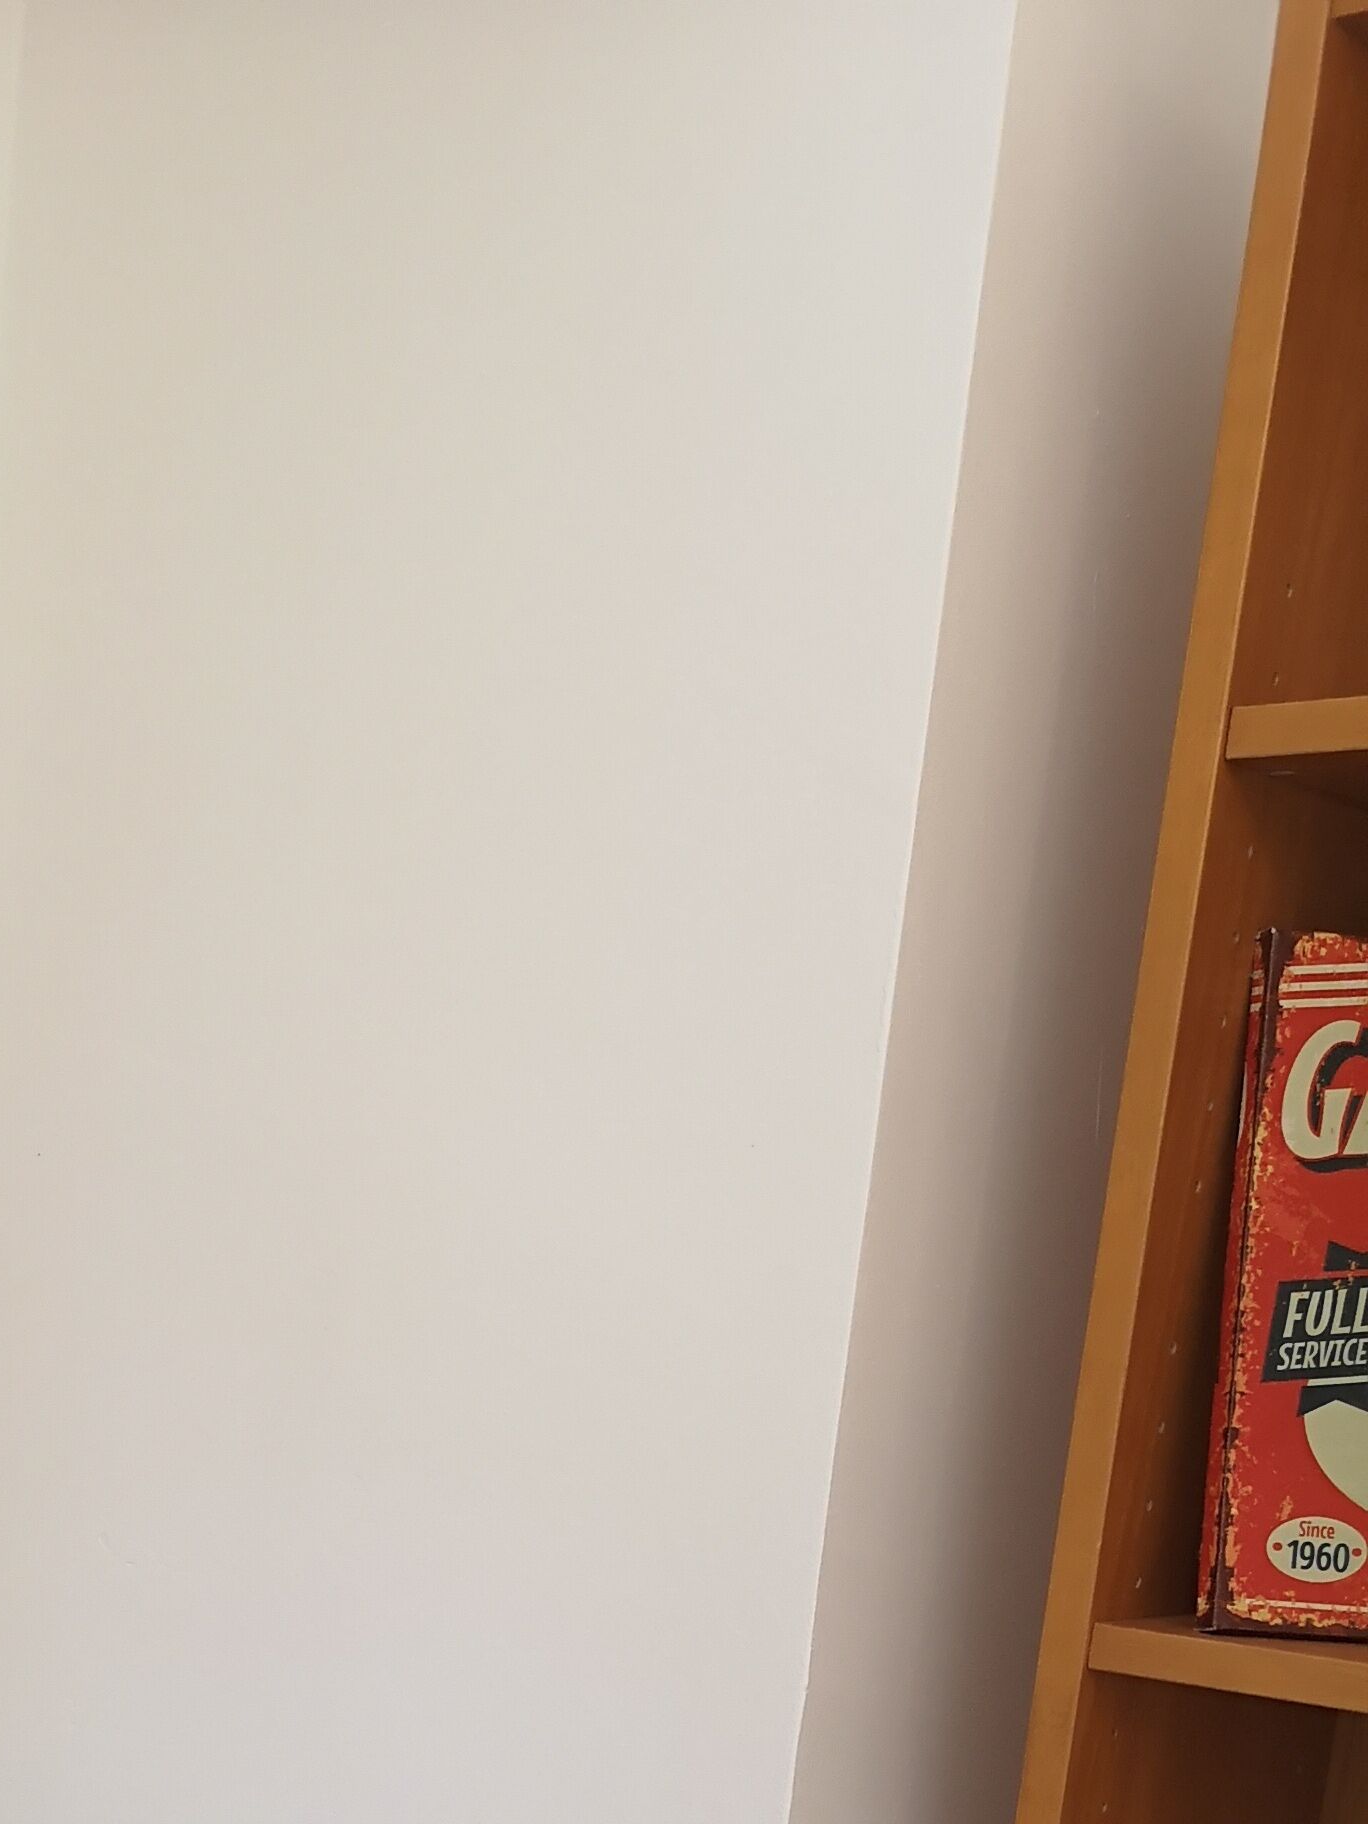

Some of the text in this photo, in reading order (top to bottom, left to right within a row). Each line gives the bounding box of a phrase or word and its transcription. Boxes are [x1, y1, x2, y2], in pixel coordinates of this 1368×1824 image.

[1281, 1019, 1368, 1159] G
[1283, 1285, 1368, 1338] FULL
[1276, 1341, 1368, 1371] SERVICE
[1298, 1521, 1334, 1540] Since
[1287, 1539, 1350, 1572] 1960
